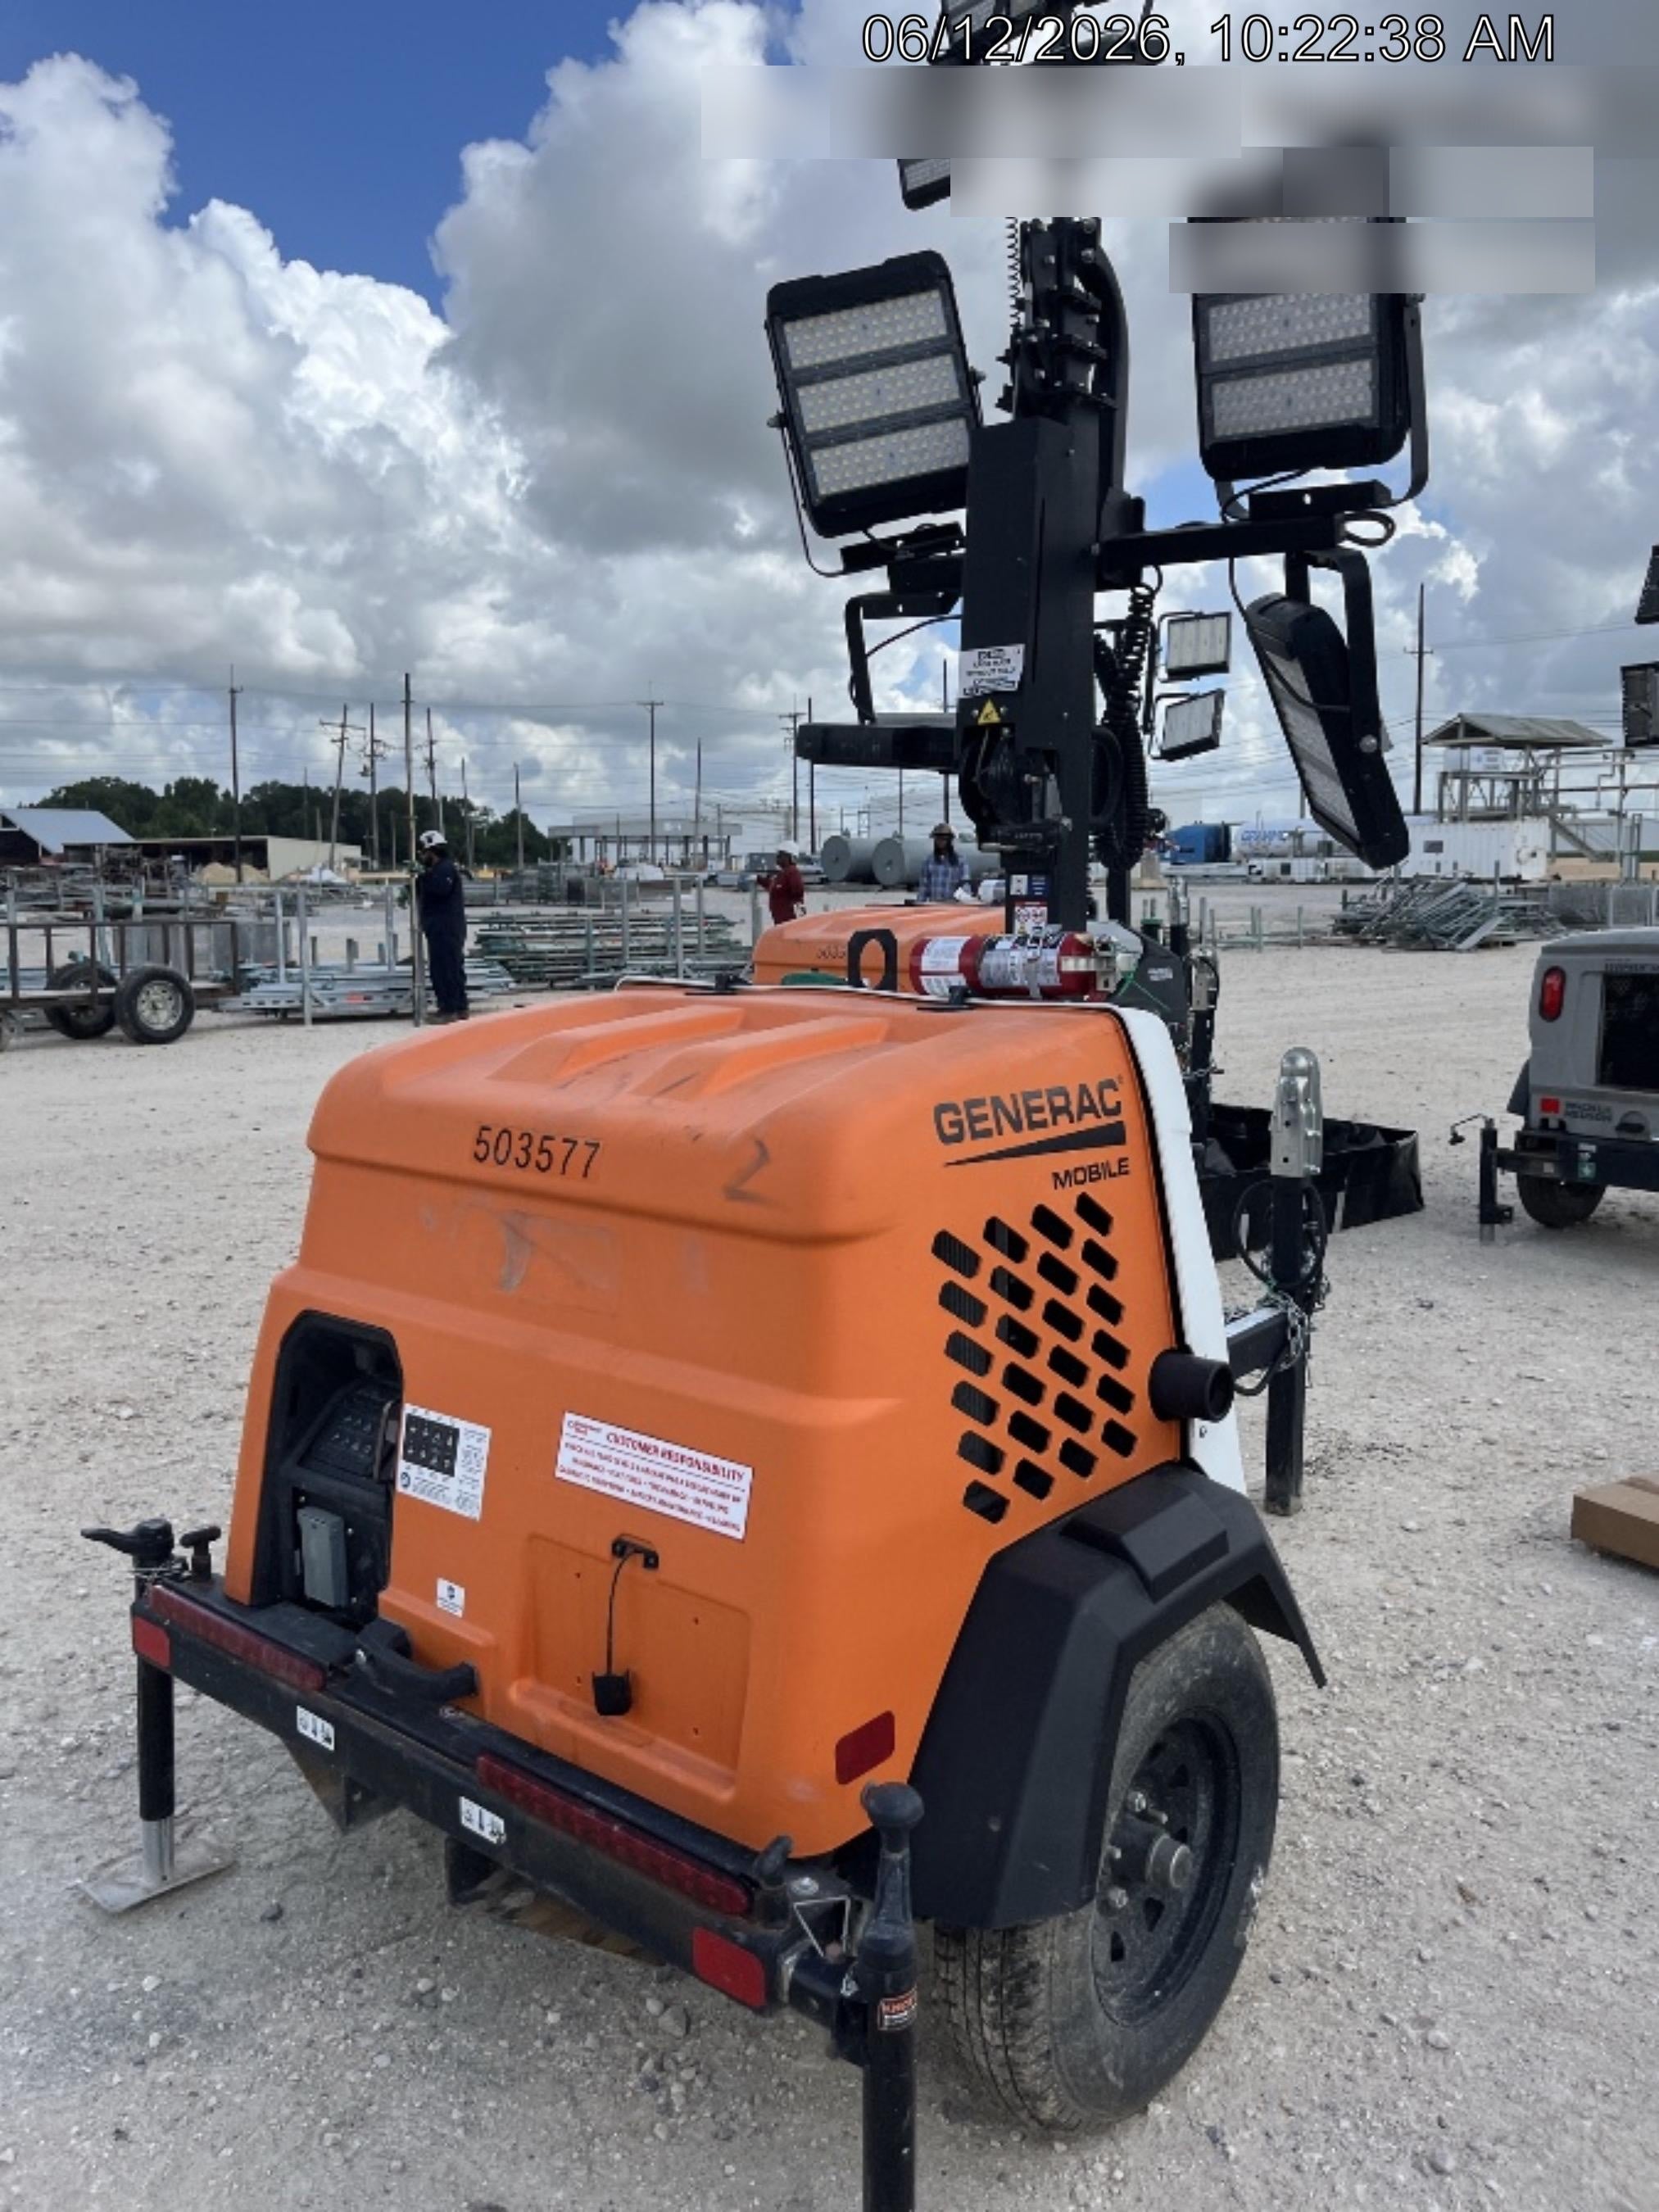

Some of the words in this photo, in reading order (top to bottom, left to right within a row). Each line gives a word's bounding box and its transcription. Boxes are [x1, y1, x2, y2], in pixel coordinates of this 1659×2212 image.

[934, 1078, 1122, 1145] GENERAC
[474, 1126, 601, 1178] 503577
[1052, 1157, 1131, 1190] MOBILE
[606, 1433, 659, 1456] CUSTOMER
